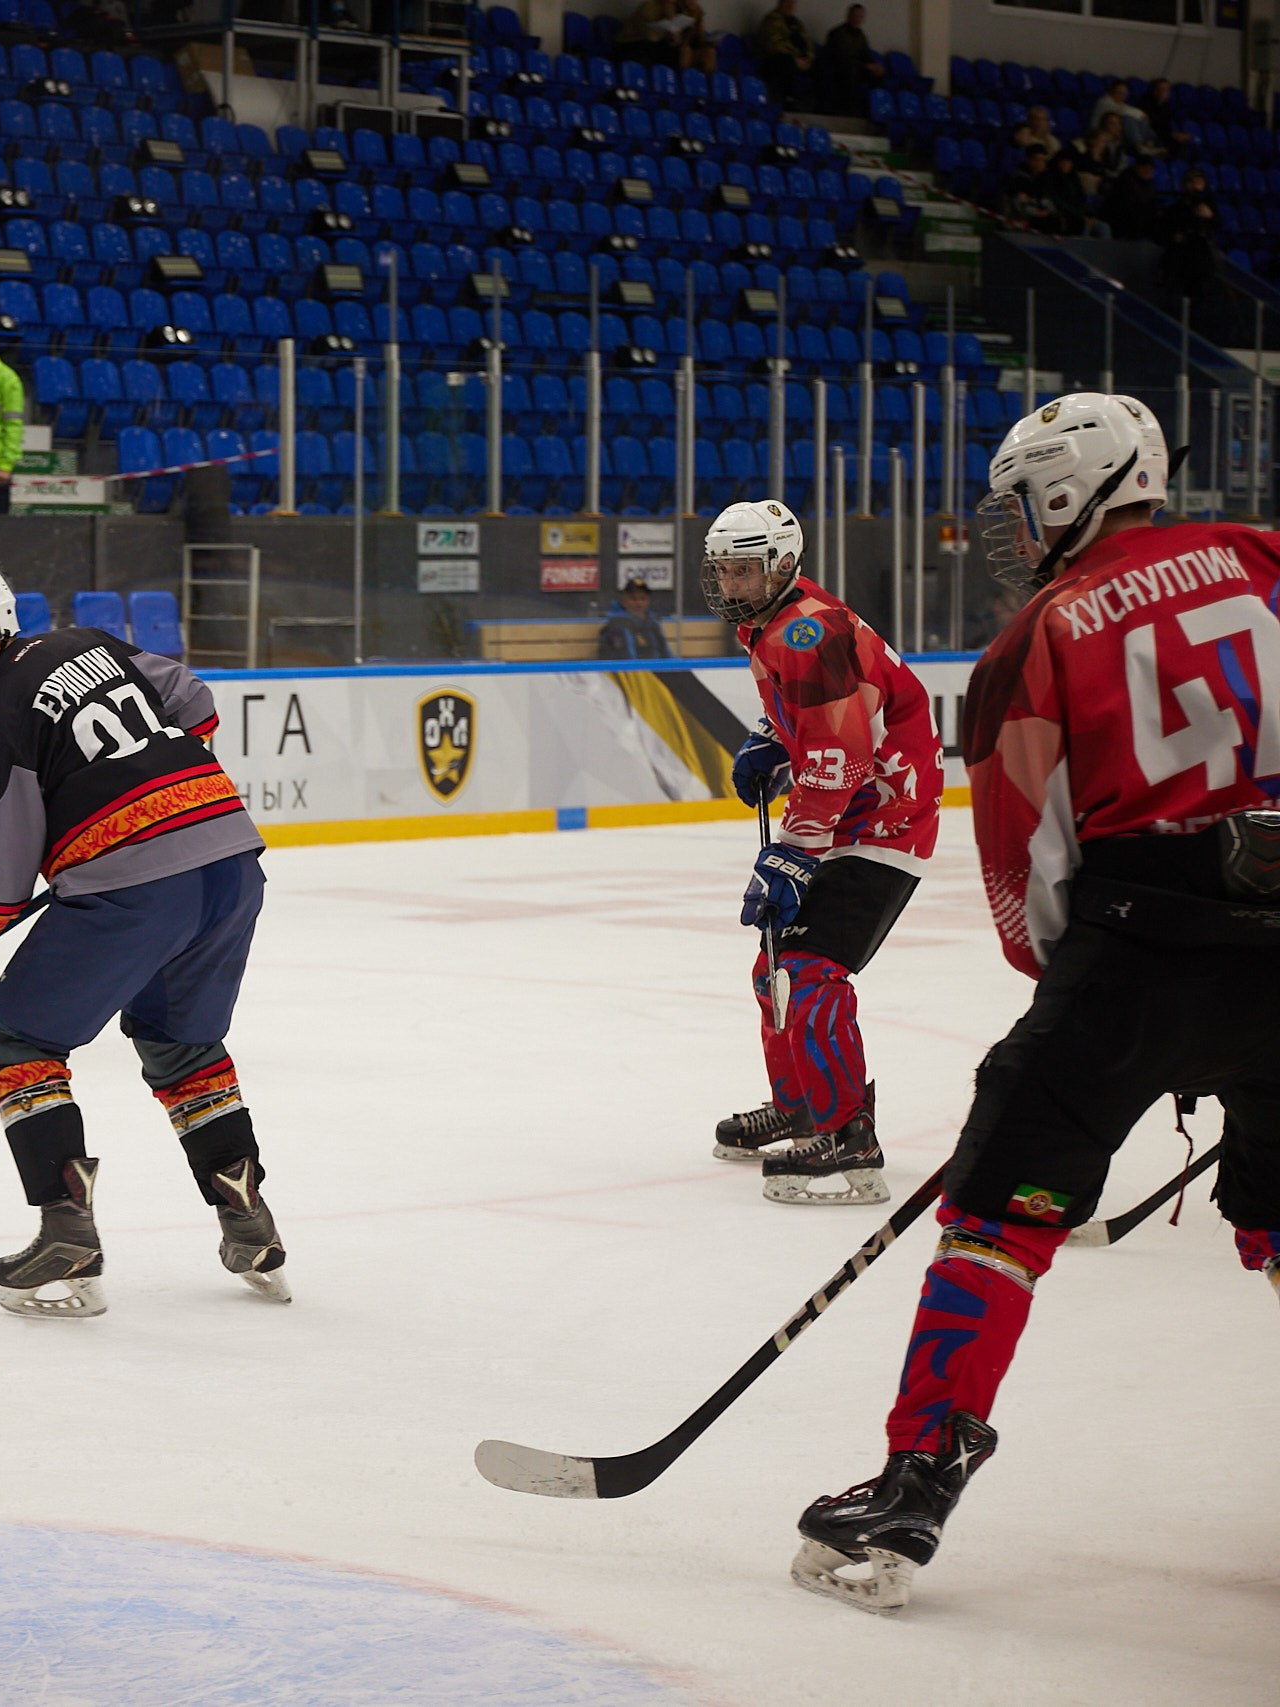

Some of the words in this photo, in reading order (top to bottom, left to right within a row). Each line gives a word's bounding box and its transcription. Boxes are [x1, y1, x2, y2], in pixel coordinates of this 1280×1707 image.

[543, 566, 598, 585] FONBET
[1057, 546, 1251, 641] ХУСНУЛЛИН
[71, 682, 186, 763] 27
[209, 692, 313, 757] ГА
[1124, 594, 1280, 791] 47
[234, 779, 308, 812] НЫХ
[780, 925, 809, 939] CM
[774, 1220, 897, 1353] CCM
